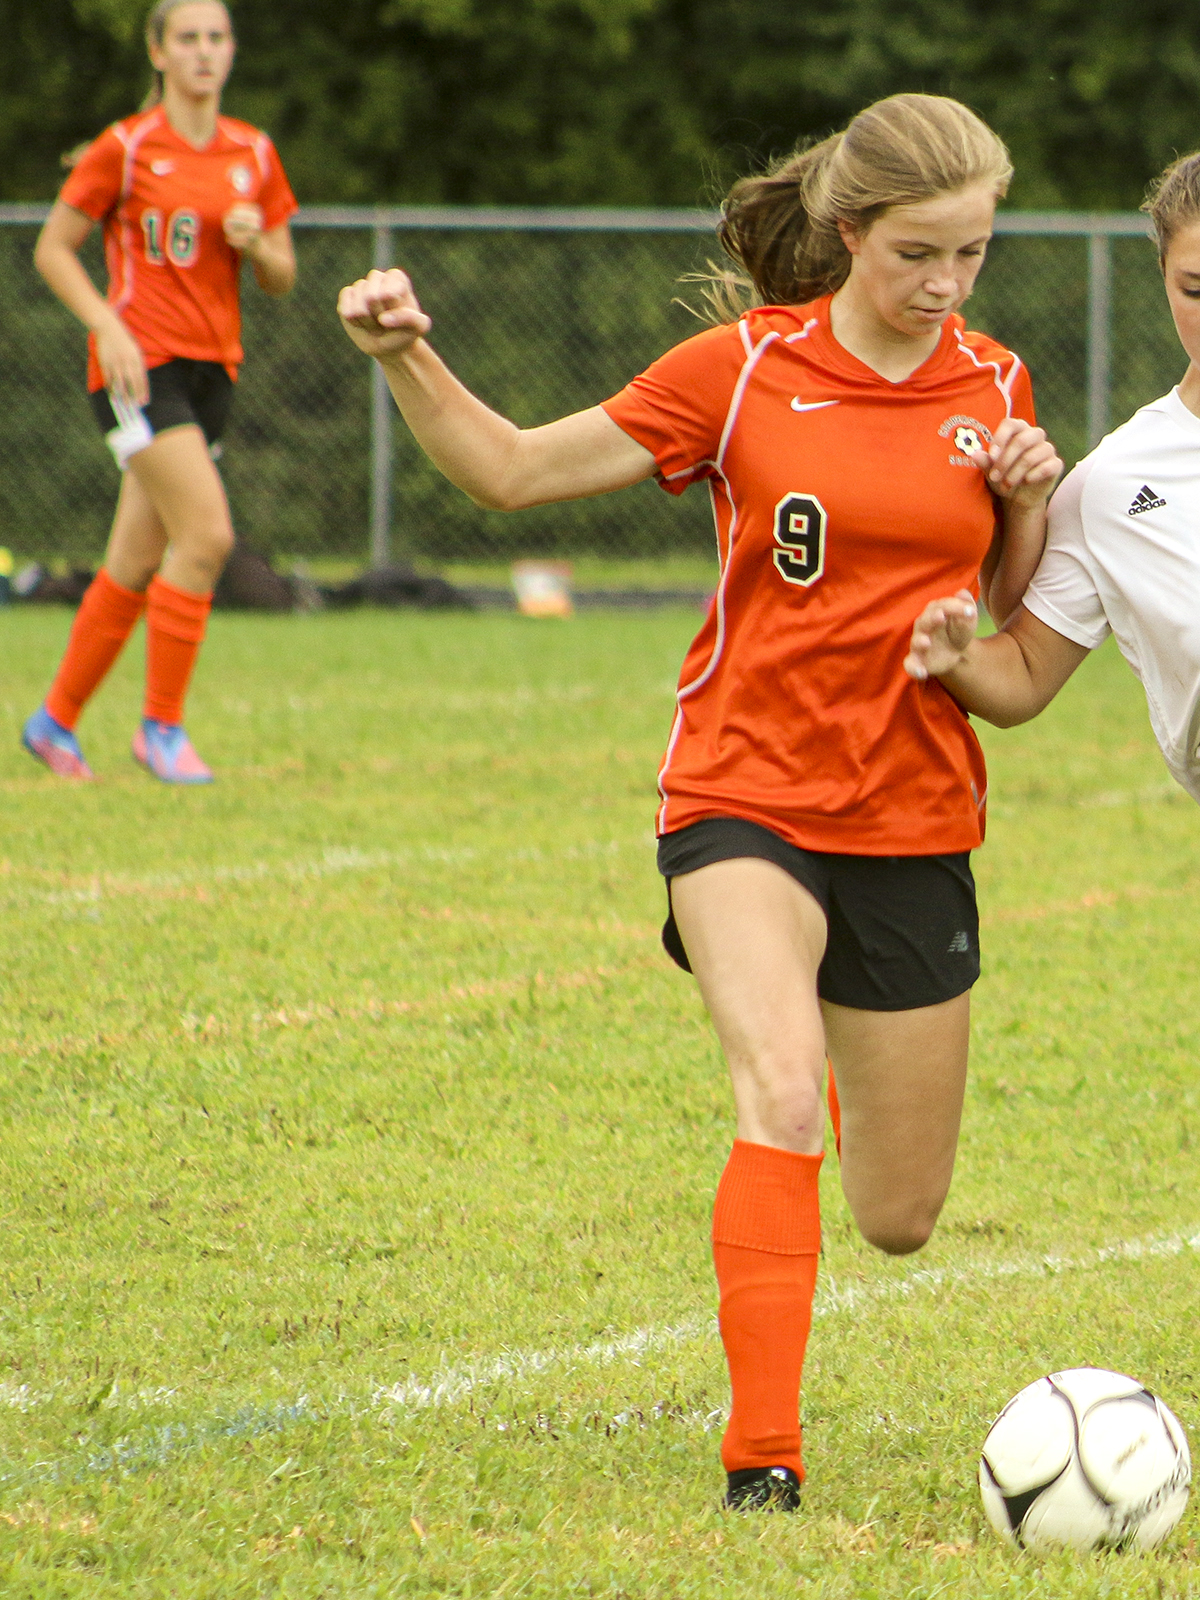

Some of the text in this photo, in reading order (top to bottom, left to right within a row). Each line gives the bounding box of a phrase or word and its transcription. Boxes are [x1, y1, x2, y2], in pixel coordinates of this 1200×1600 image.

[140, 207, 200, 267] 16
[1128, 498, 1167, 515] adidas
[772, 491, 827, 588] 9
